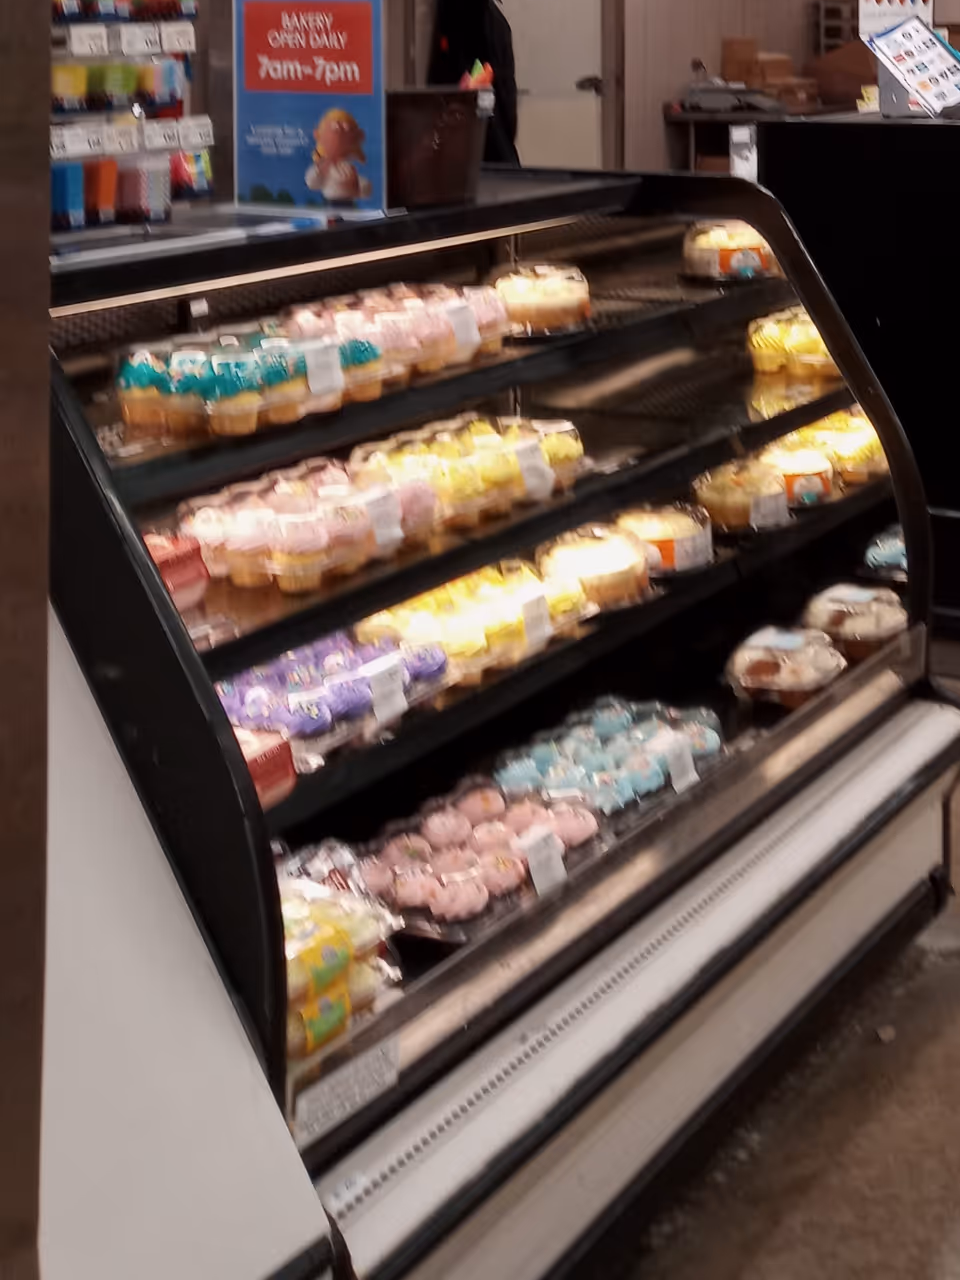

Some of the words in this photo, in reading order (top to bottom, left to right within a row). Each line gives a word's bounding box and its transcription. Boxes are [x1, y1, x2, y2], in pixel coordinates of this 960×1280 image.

[280, 11, 334, 32] BAKERY
[267, 29, 306, 49] OPEN
[309, 31, 348, 50] DAILY
